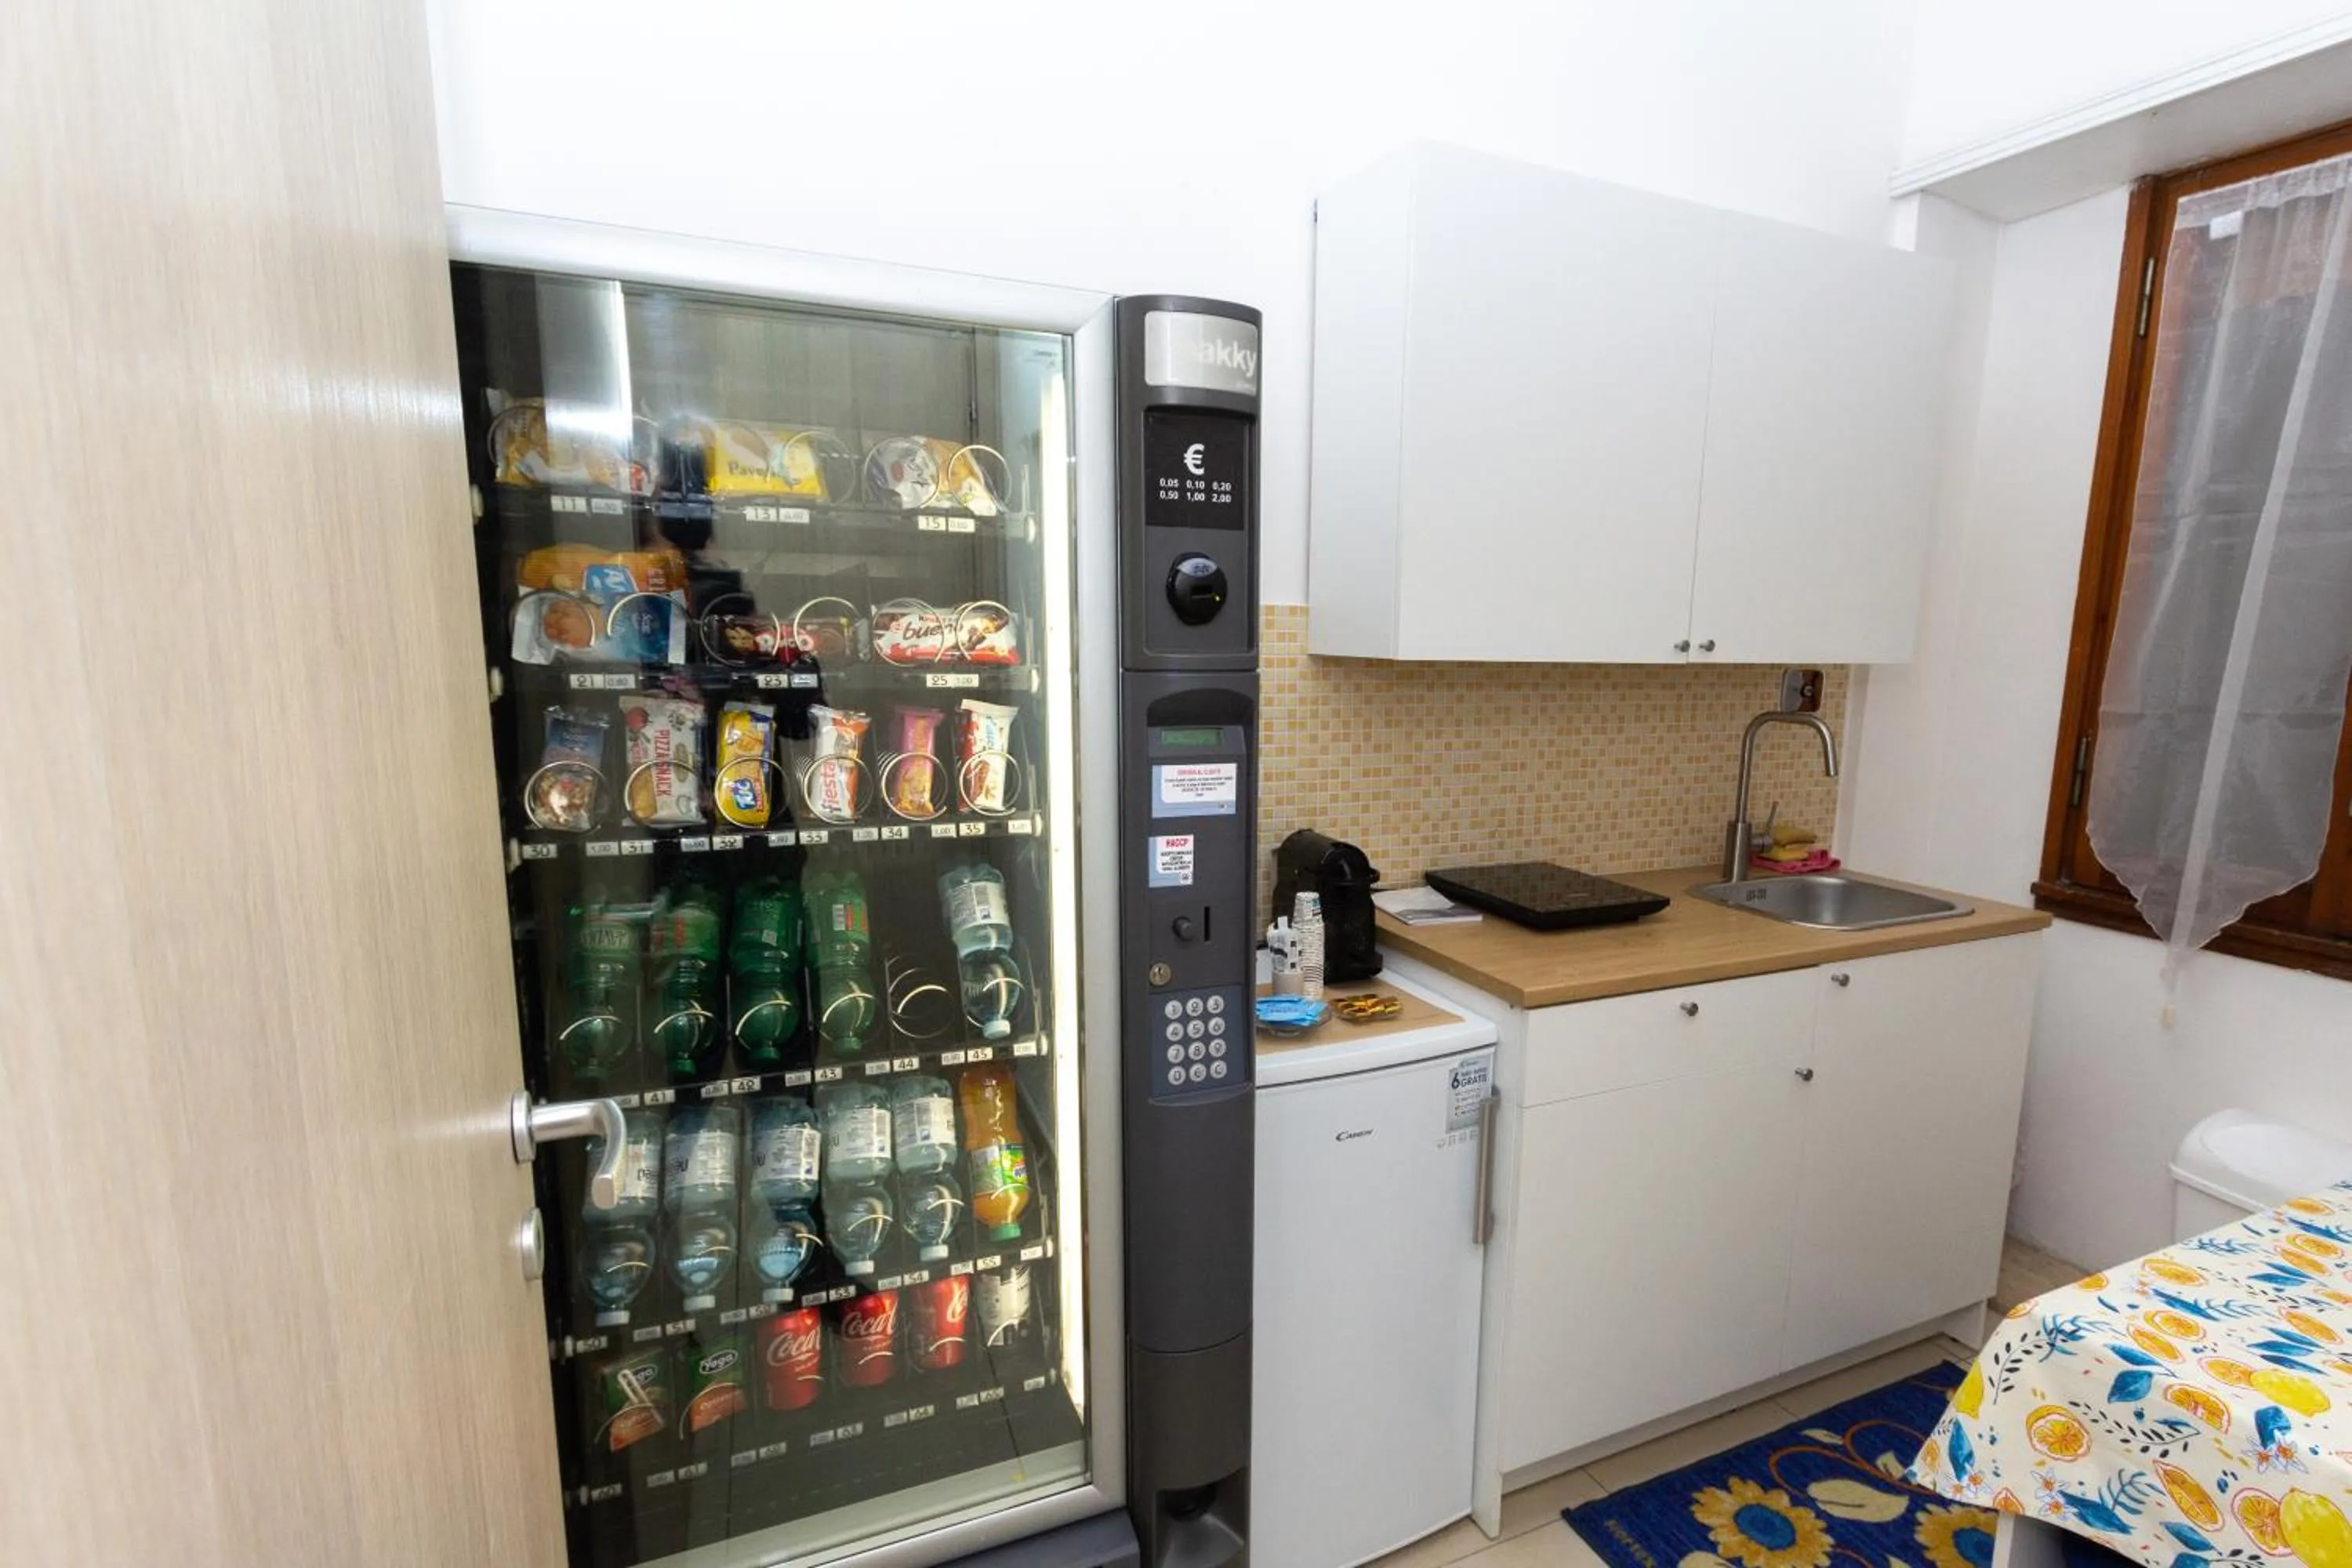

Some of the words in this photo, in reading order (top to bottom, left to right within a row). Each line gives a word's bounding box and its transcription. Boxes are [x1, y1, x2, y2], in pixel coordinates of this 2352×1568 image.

[1184, 444, 1205, 475] €
[925, 517, 941, 528] 15
[576, 675, 594, 687] 21
[931, 675, 949, 686] 25
[654, 729, 670, 758] PIZZA
[655, 761, 672, 797] SNACK
[887, 828, 902, 838] 34
[965, 824, 980, 834] 35
[1191, 1002, 1199, 1013] 2
[1192, 1023, 1200, 1034] 5
[1214, 1021, 1221, 1031] 6
[973, 1050, 988, 1059] 45
[1194, 1045, 1201, 1055] 8
[899, 1059, 914, 1069] 44
[820, 1069, 837, 1080] 43
[1451, 1072, 1460, 1089] 6
[702, 1353, 734, 1370] Yoga
